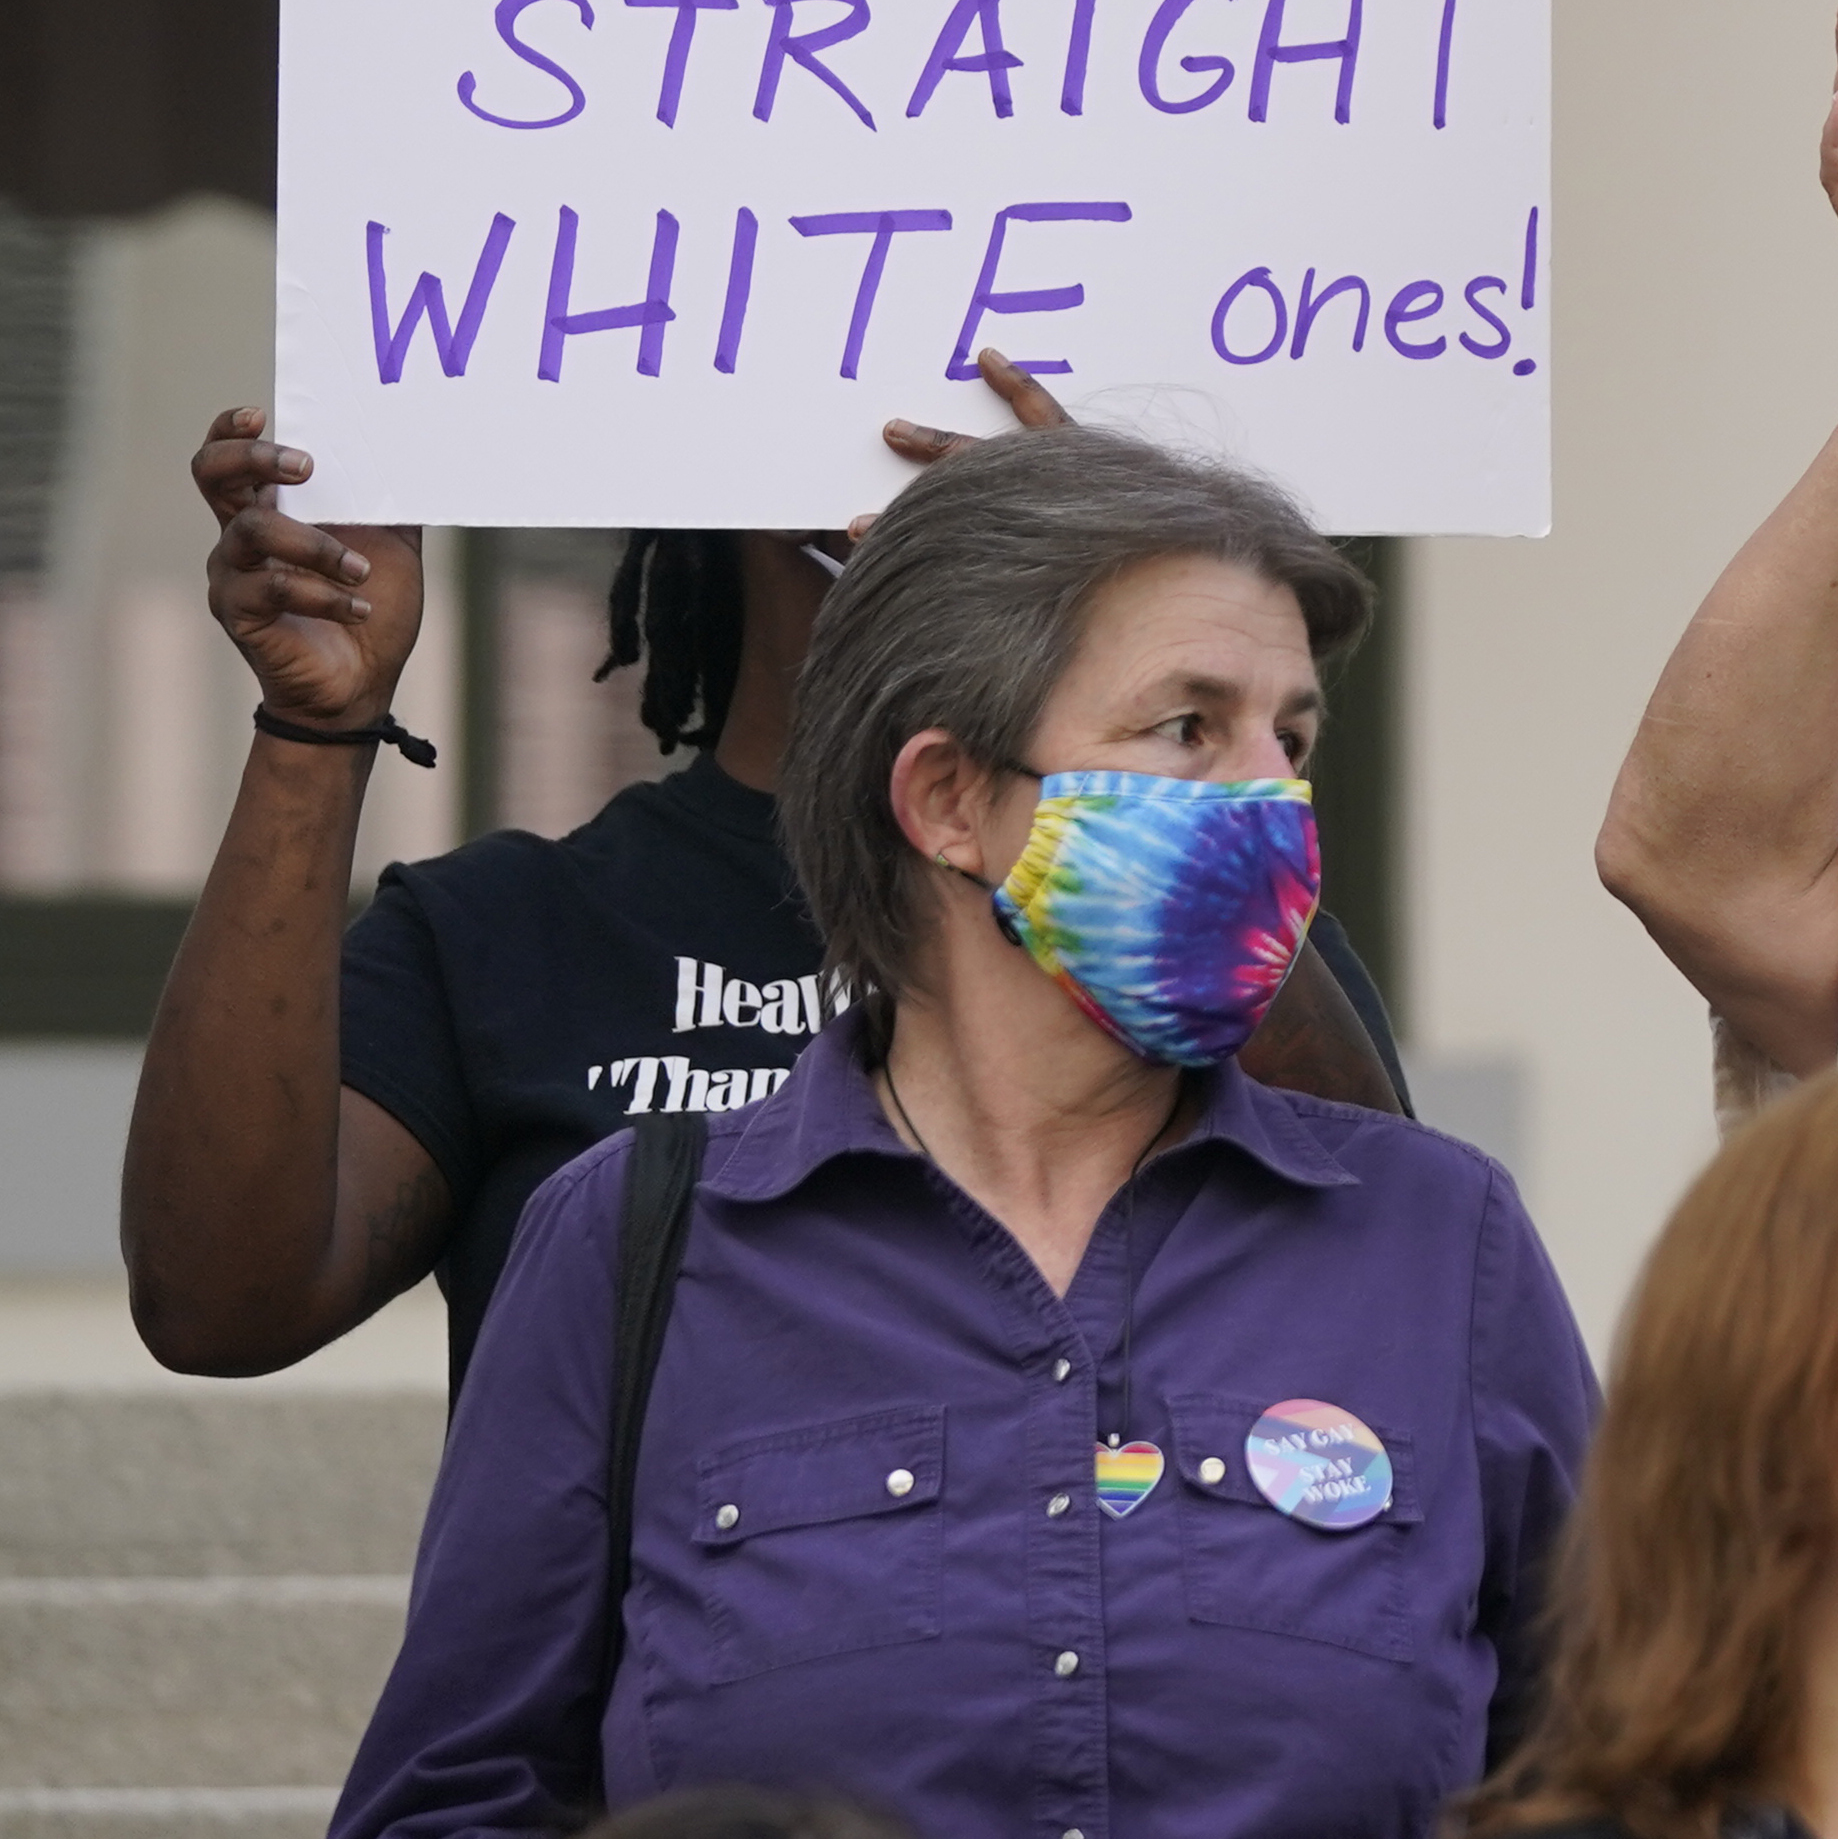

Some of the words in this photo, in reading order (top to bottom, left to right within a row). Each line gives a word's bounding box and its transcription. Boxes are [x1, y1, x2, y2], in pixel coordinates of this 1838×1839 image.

[365, 200, 1132, 386] WHITE
[1209, 204, 1538, 378] ones!
[672, 956, 879, 1035] Heav
[1263, 1432, 1307, 1455] SAY
[1310, 1423, 1355, 1448] GAY
[1299, 1457, 1353, 1483] STAY
[1302, 1475, 1371, 1504] WOKE
